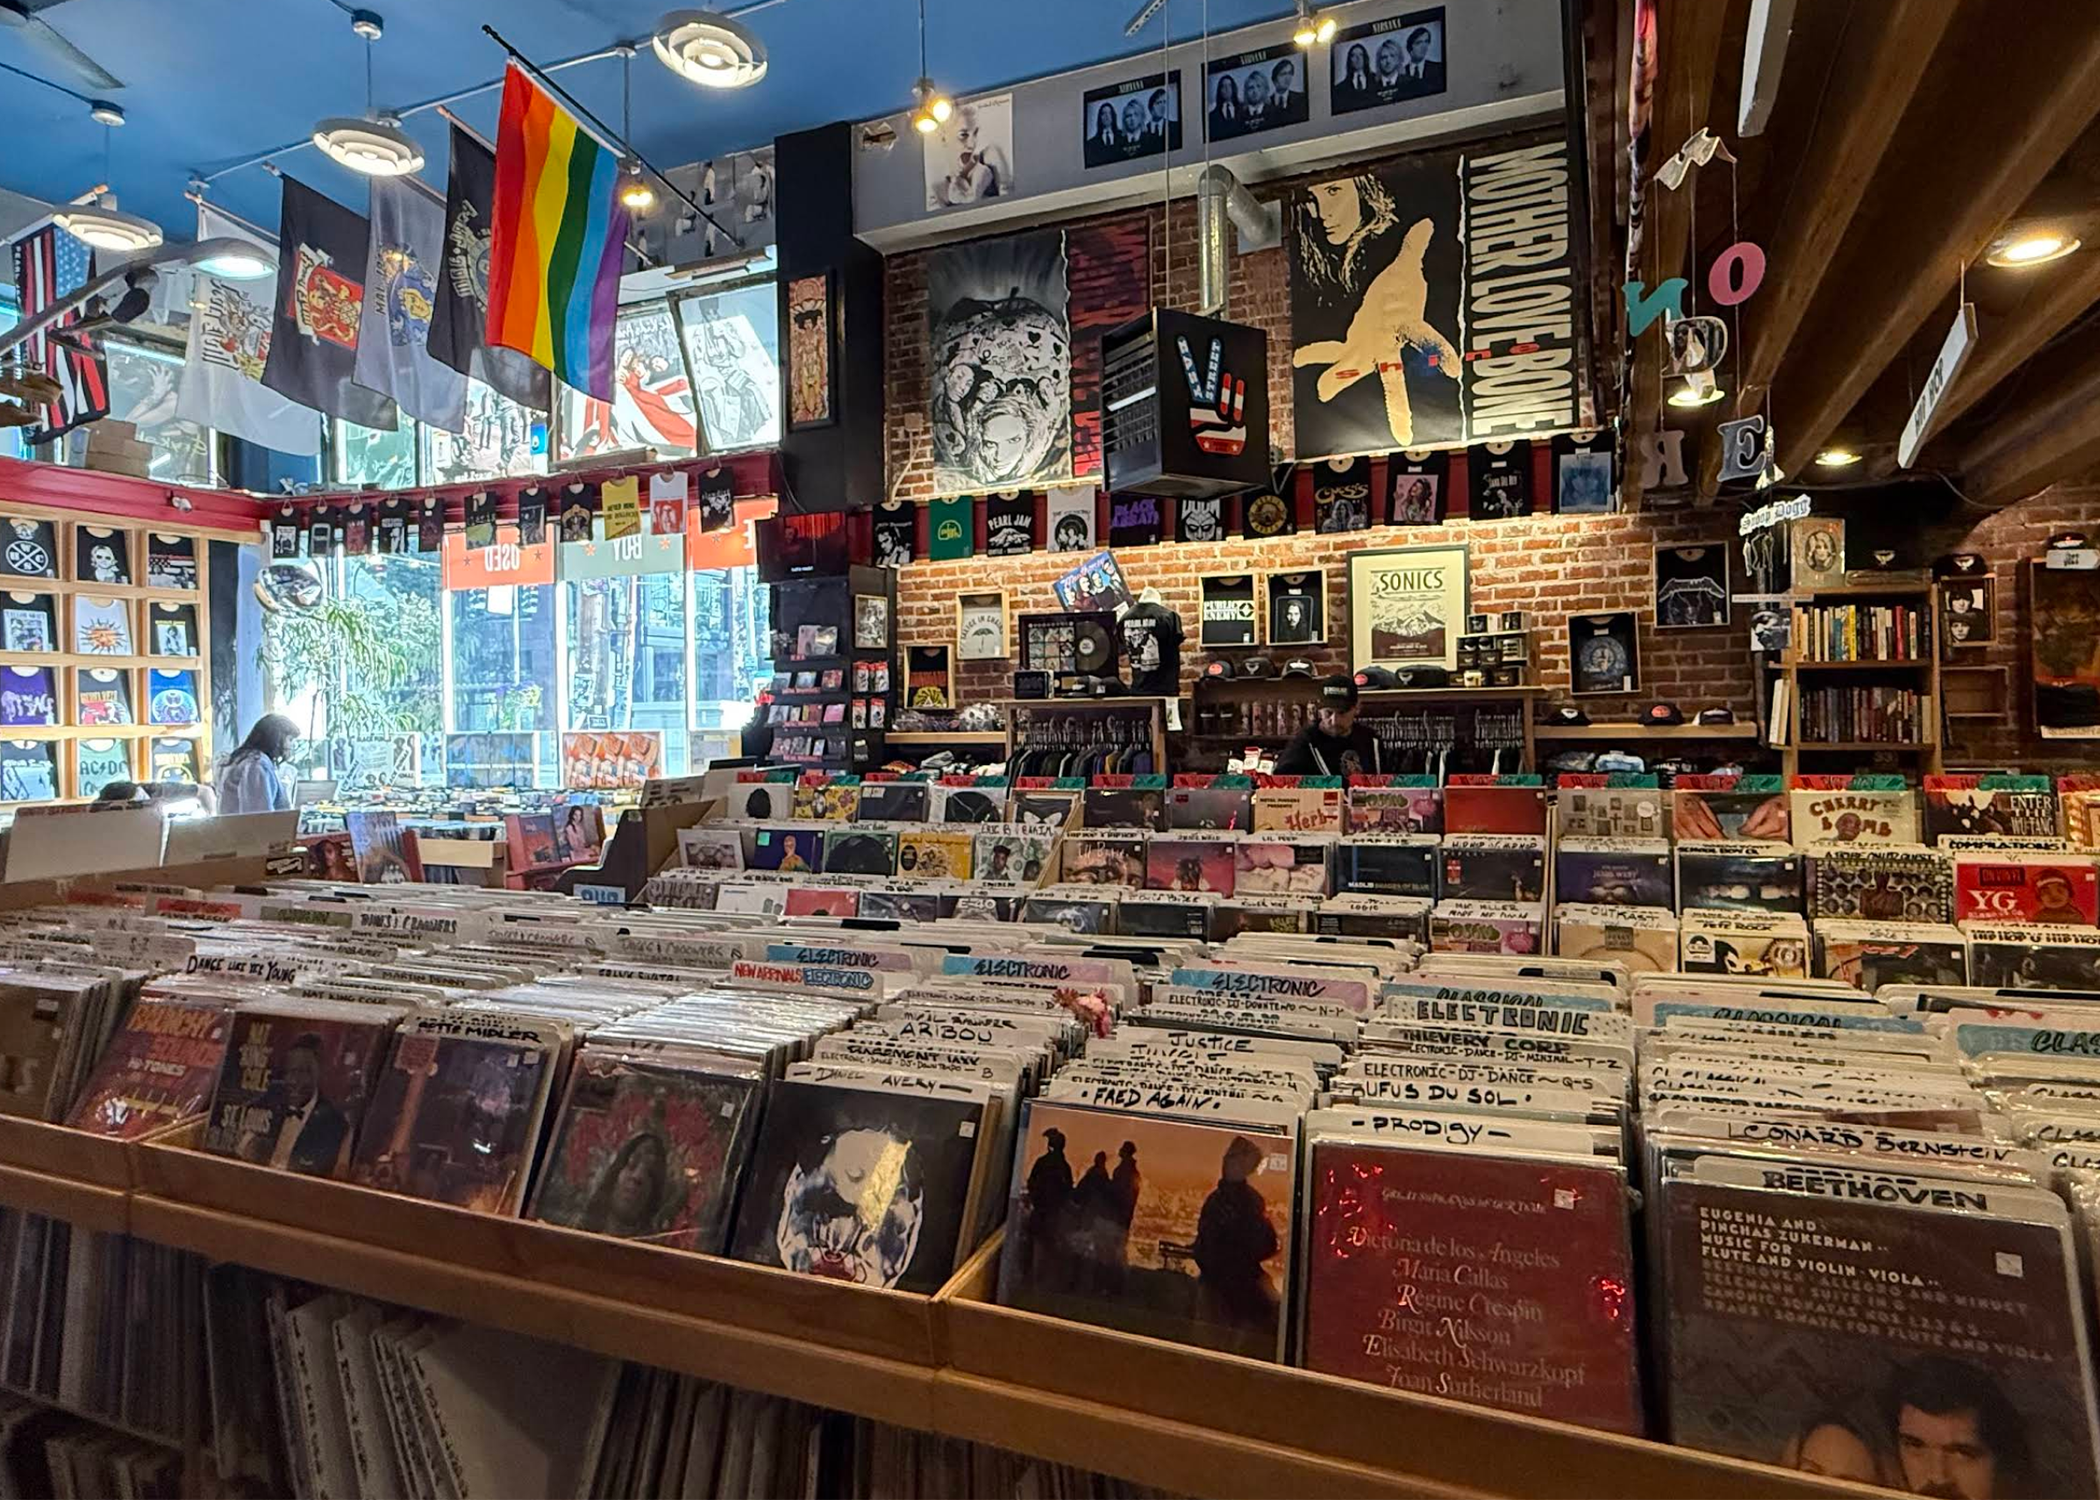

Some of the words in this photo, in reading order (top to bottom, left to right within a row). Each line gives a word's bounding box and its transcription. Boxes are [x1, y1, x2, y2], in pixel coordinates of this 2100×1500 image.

[1469, 141, 1568, 276] MOTHER
[1471, 267, 1573, 351] LOVE
[1178, 337, 1203, 398] EASY
[1206, 341, 1221, 400] STREET
[1472, 346, 1573, 436] BONE
[1775, 500, 1808, 516] Dogg
[988, 514, 1013, 531] PEARL
[1014, 513, 1032, 528] JAM
[1380, 570, 1443, 591] SONICS
[1204, 600, 1239, 611] PUBLIC
[1204, 610, 1237, 621] ENEMY
[1809, 796, 1879, 816] CHERRY
[2010, 795, 2053, 809] ENTER
[2015, 809, 2047, 817] THE
[1967, 890, 2018, 911] YG
[1590, 907, 1659, 921] OUTKAST
[796, 948, 879, 967] ELECTRONIC
[186, 955, 224, 974] DANCE
[266, 961, 297, 984] YOUNG
[734, 963, 756, 977] NEW
[803, 968, 874, 989] ELECTRONIC
[974, 959, 1071, 980] ELECTRONIC
[303, 989, 322, 999] NAT
[328, 992, 354, 1002] KING
[1212, 974, 1326, 997] ELECTRONIC
[1417, 1000, 1590, 1036] ELECTRONIC
[464, 1025, 542, 1044] MIDLER
[1401, 1031, 1490, 1049] THIEVERY
[821, 1051, 865, 1064] ELECTRONIC
[882, 1075, 937, 1094] AVERY
[1428, 1085, 1459, 1101] DU
[1467, 1090, 1518, 1106] SOL
[1762, 1171, 1988, 1211] BEETHOVEN
[1700, 1207, 1776, 1227] EUGENIA
[1781, 1218, 1817, 1233] AND
[1700, 1220, 1772, 1240] PINCHAS
[1778, 1229, 1873, 1253] ZUKERMAN
[1700, 1234, 1752, 1251] MUSIC
[1760, 1241, 1793, 1256] FOR
[1423, 1238, 1448, 1256] de
[1451, 1238, 1475, 1260] los
[1394, 1258, 1452, 1284] Maria
[1453, 1264, 1509, 1291] Callas
[1702, 1246, 1752, 1264] FLUTE
[1756, 1253, 1792, 1269] AND
[1797, 1259, 1857, 1278] VIOLIN
[1868, 1268, 1926, 1287] VIOLA
[1469, 1293, 1544, 1324] Crespin
[1377, 1307, 1433, 1336] Birgit
[1435, 1316, 1512, 1348] Nilsson
[1362, 1333, 1456, 1367] Elisabeth
[1457, 1347, 1587, 1389] Schwarzkopf
[1385, 1365, 1434, 1391] Joan
[1435, 1371, 1544, 1408] Sutherland
